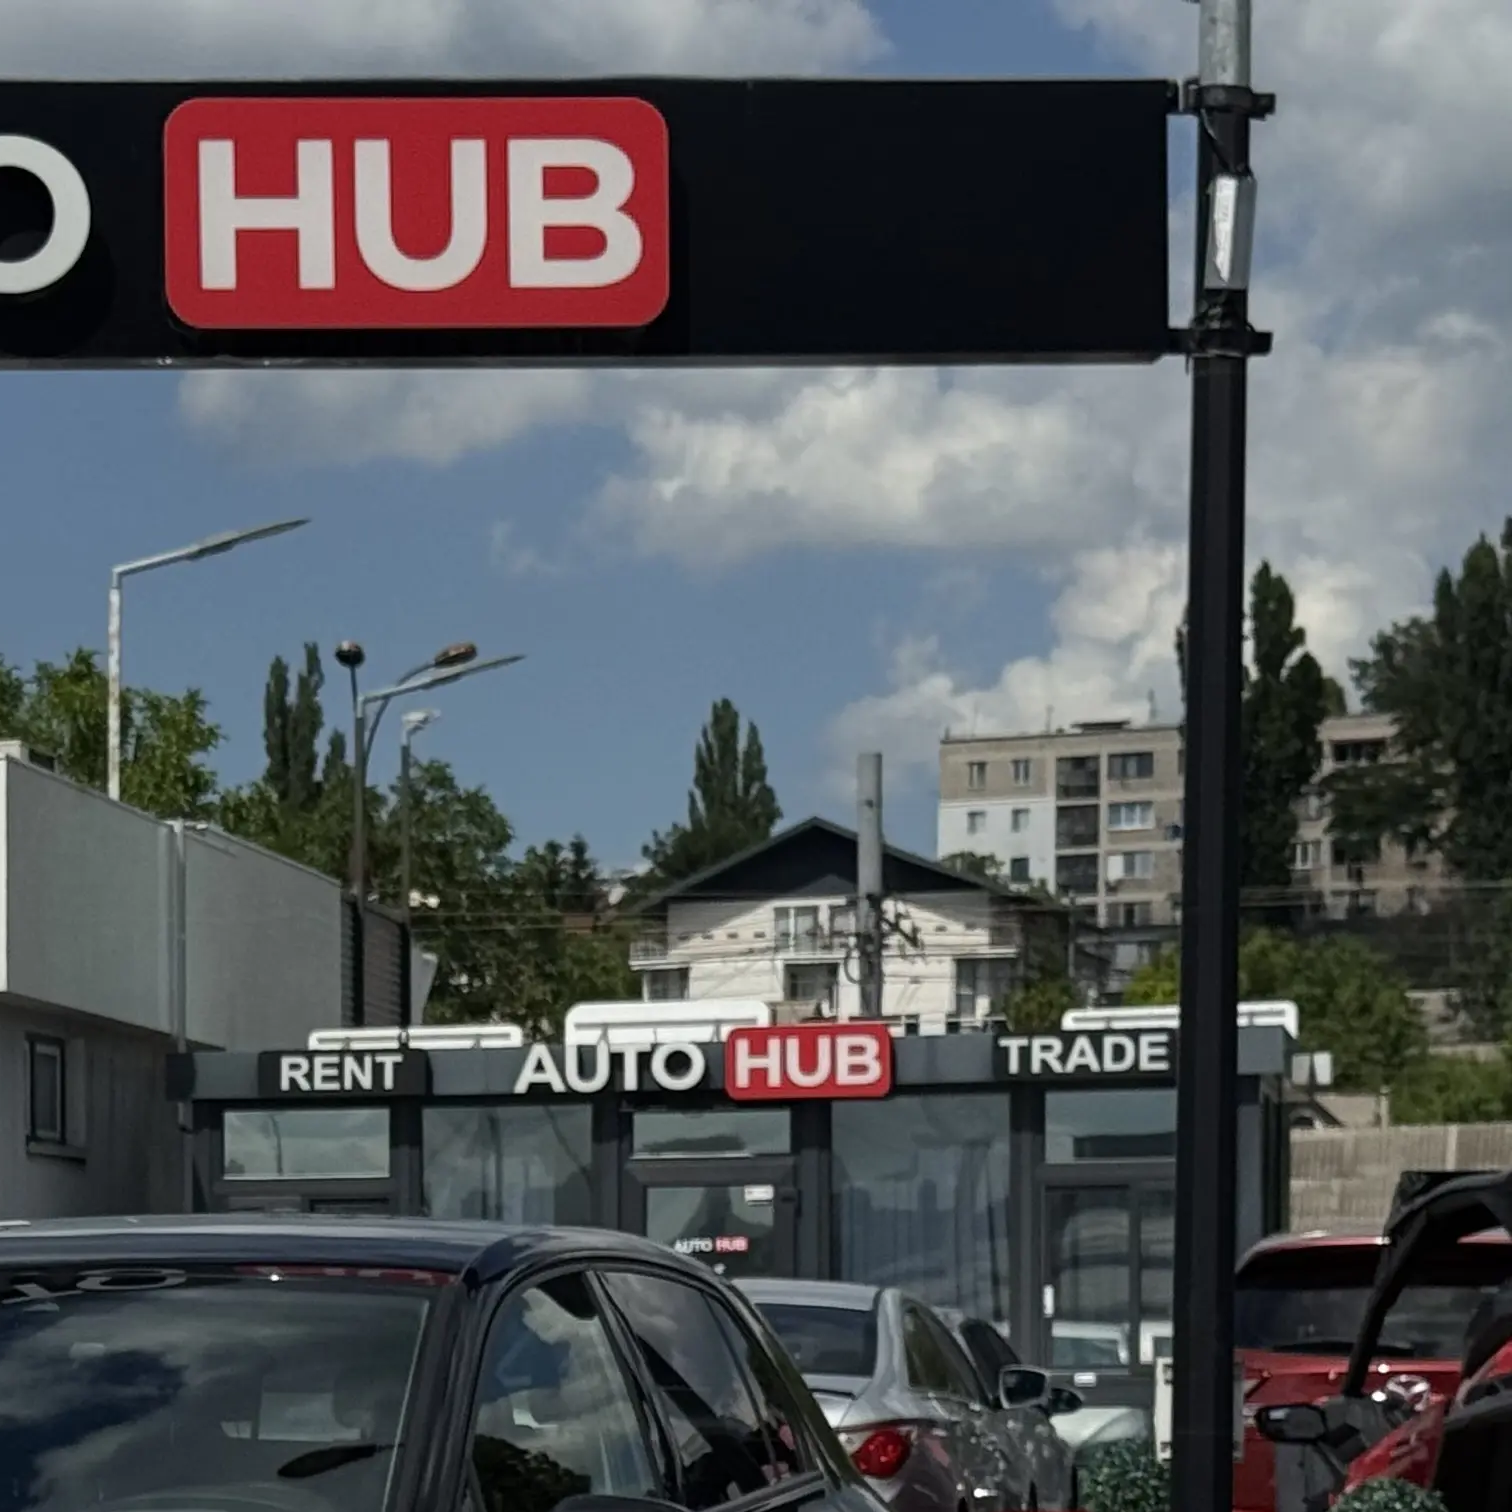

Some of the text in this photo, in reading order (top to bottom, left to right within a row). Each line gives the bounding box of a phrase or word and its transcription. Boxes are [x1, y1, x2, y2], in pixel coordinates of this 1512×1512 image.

[199, 139, 642, 291] HUB
[280, 1054, 404, 1091] RENT
[514, 1034, 882, 1093] AUTO HUB
[998, 1033, 1170, 1075] TRADE
[673, 1236, 748, 1254] AUTO HUB
